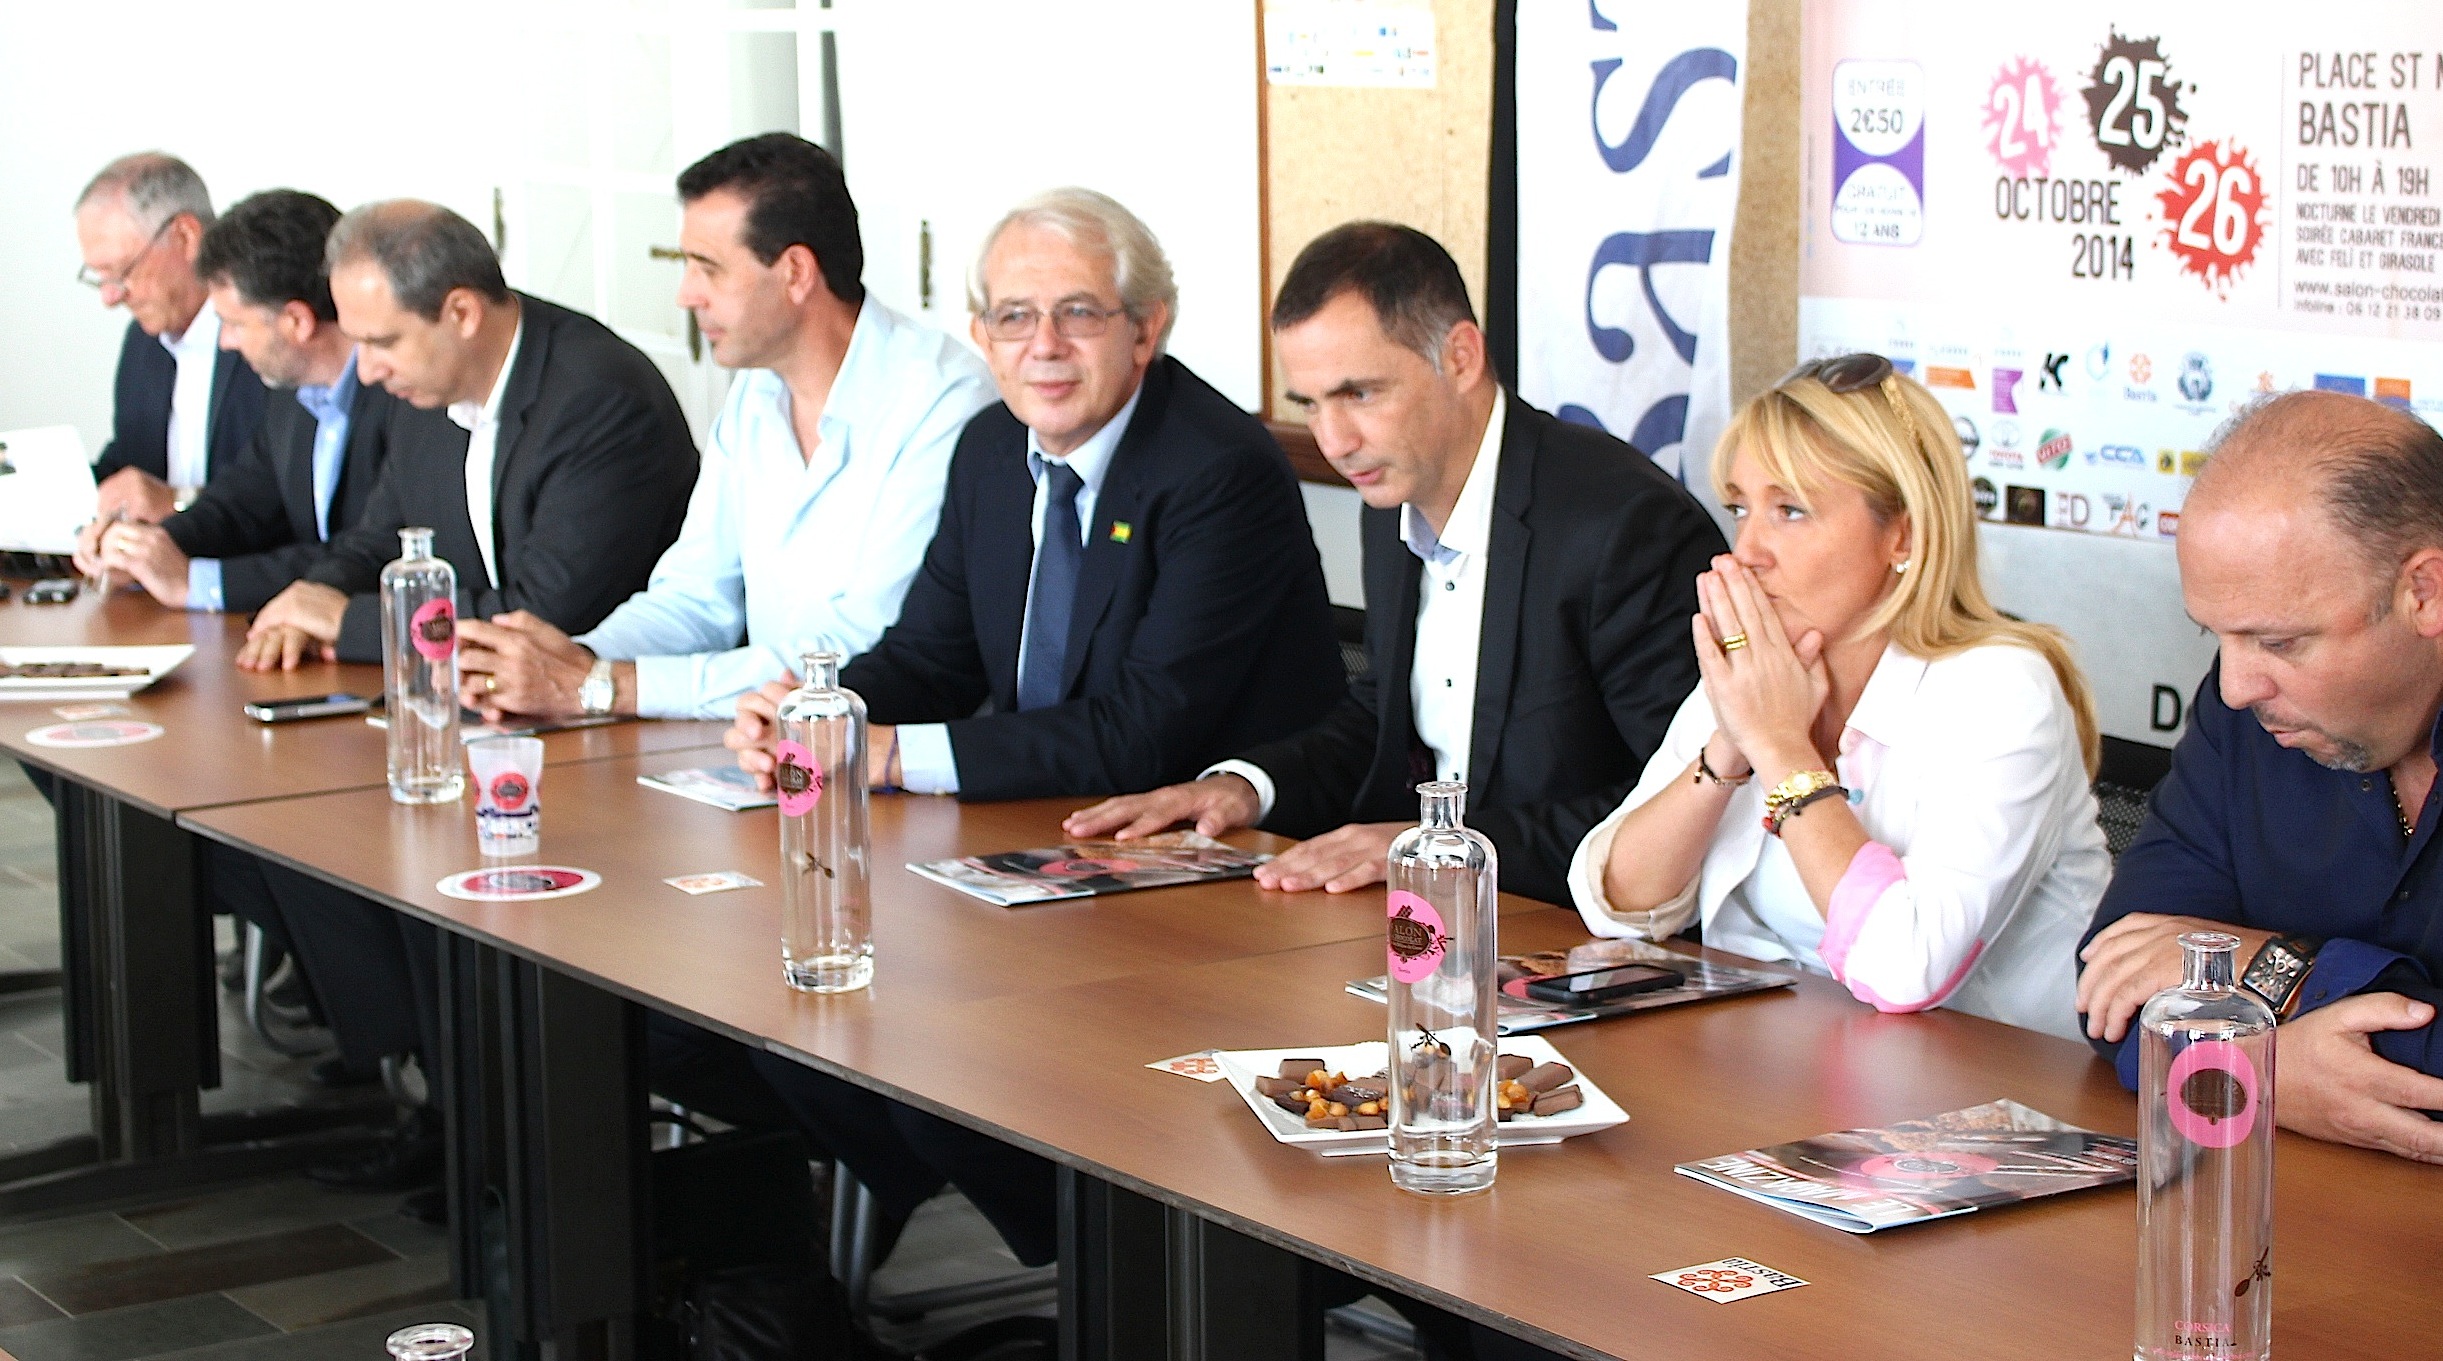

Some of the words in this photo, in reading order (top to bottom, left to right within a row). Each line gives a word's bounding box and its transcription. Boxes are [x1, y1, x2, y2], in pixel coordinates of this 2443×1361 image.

[2300, 52, 2377, 89] PLACE
[2391, 53, 2422, 90] ST
[1850, 107, 1904, 134] 2€50
[1993, 73, 2049, 158] 24
[2098, 56, 2166, 149] 25
[2300, 101, 2411, 149] BASTIA
[2297, 163, 2319, 192] DE
[2331, 163, 2362, 193] 10H
[2371, 158, 2385, 194] À
[2398, 165, 2429, 195] 19H
[1995, 176, 2121, 225] OCTOBRE
[2178, 157, 2251, 256] 26
[2296, 202, 2356, 223] NOCTURNE
[2362, 204, 2376, 224] LE
[2382, 205, 2441, 227] VENDREDI
[1873, 222, 1900, 239] ANS
[2296, 223, 2333, 244] SOIRÉE
[2341, 228, 2394, 247] CABARET
[2072, 233, 2133, 281] 2014
[2296, 247, 2325, 266] AVEC
[2359, 250, 2373, 269] ET
[2379, 252, 2435, 273] GIRASOLE
[1851, 1198, 1918, 1217] LE
[2175, 1335, 2230, 1348] BASTIA
